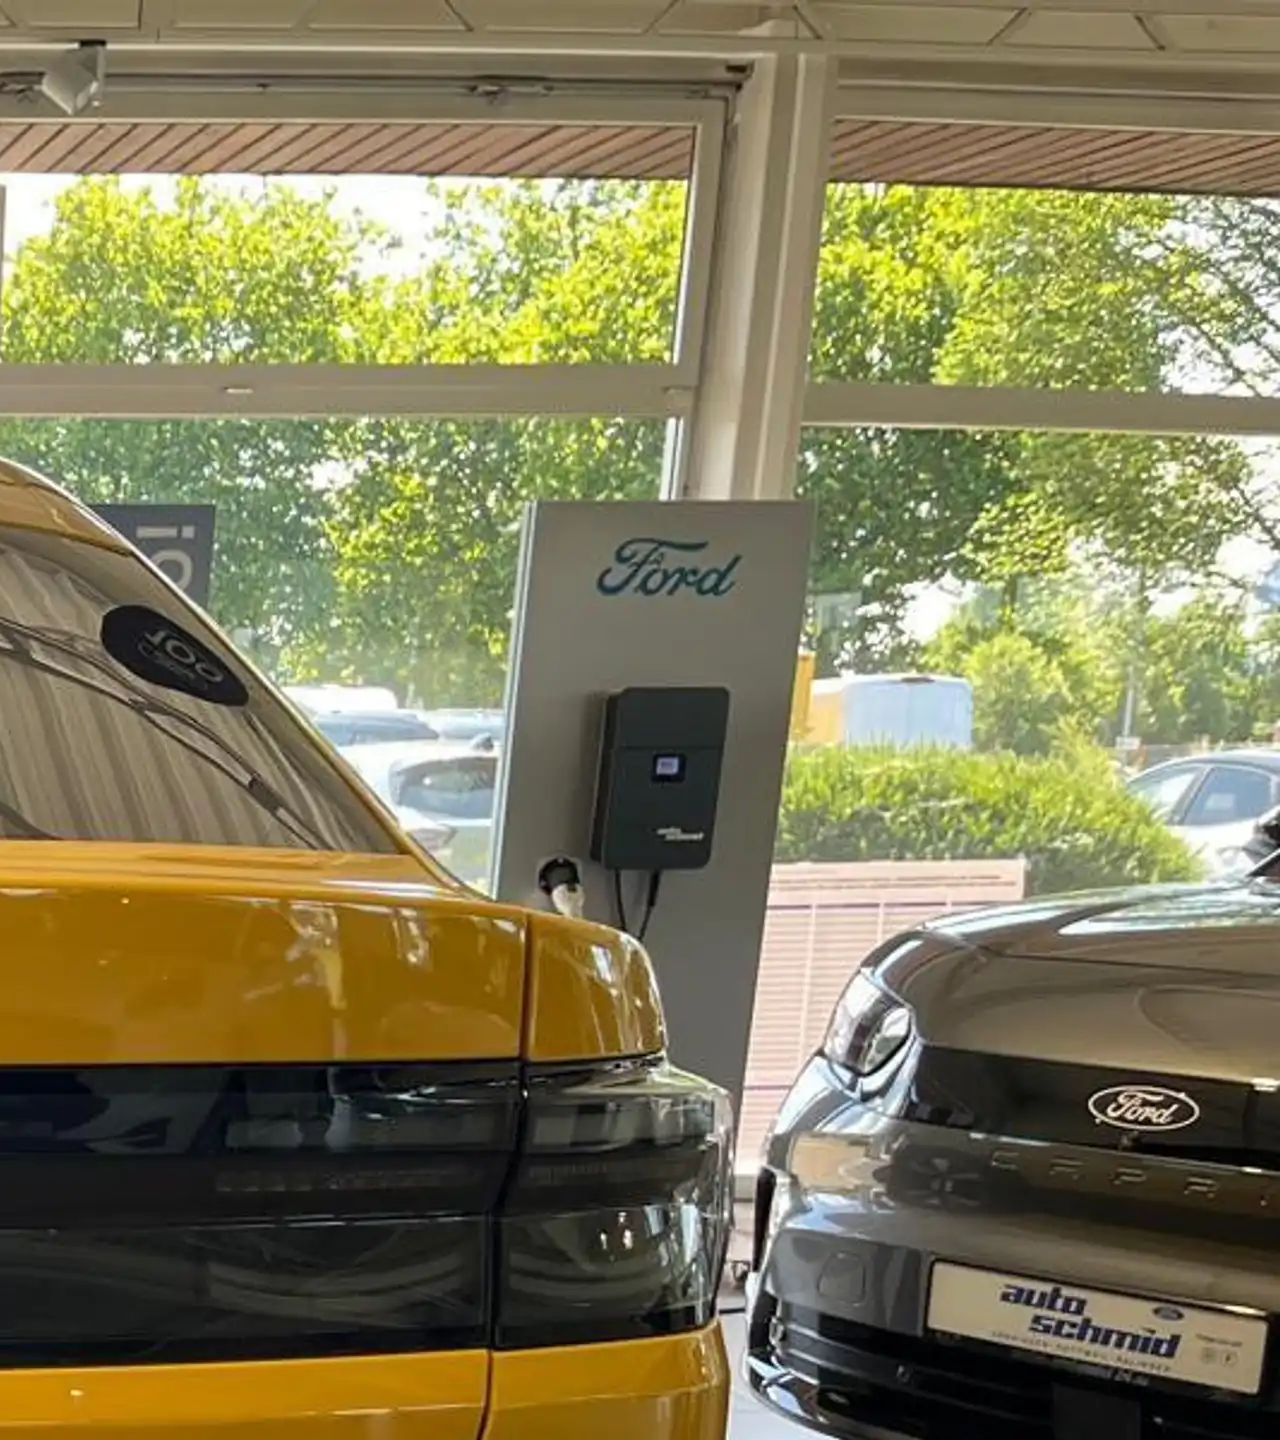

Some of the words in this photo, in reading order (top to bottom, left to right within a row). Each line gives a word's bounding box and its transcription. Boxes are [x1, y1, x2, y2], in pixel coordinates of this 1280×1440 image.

[597, 538, 743, 597] Ford
[1107, 1091, 1178, 1125] Ford
[1000, 1285, 1088, 1316] auto
[1028, 1314, 1182, 1359] schmid
